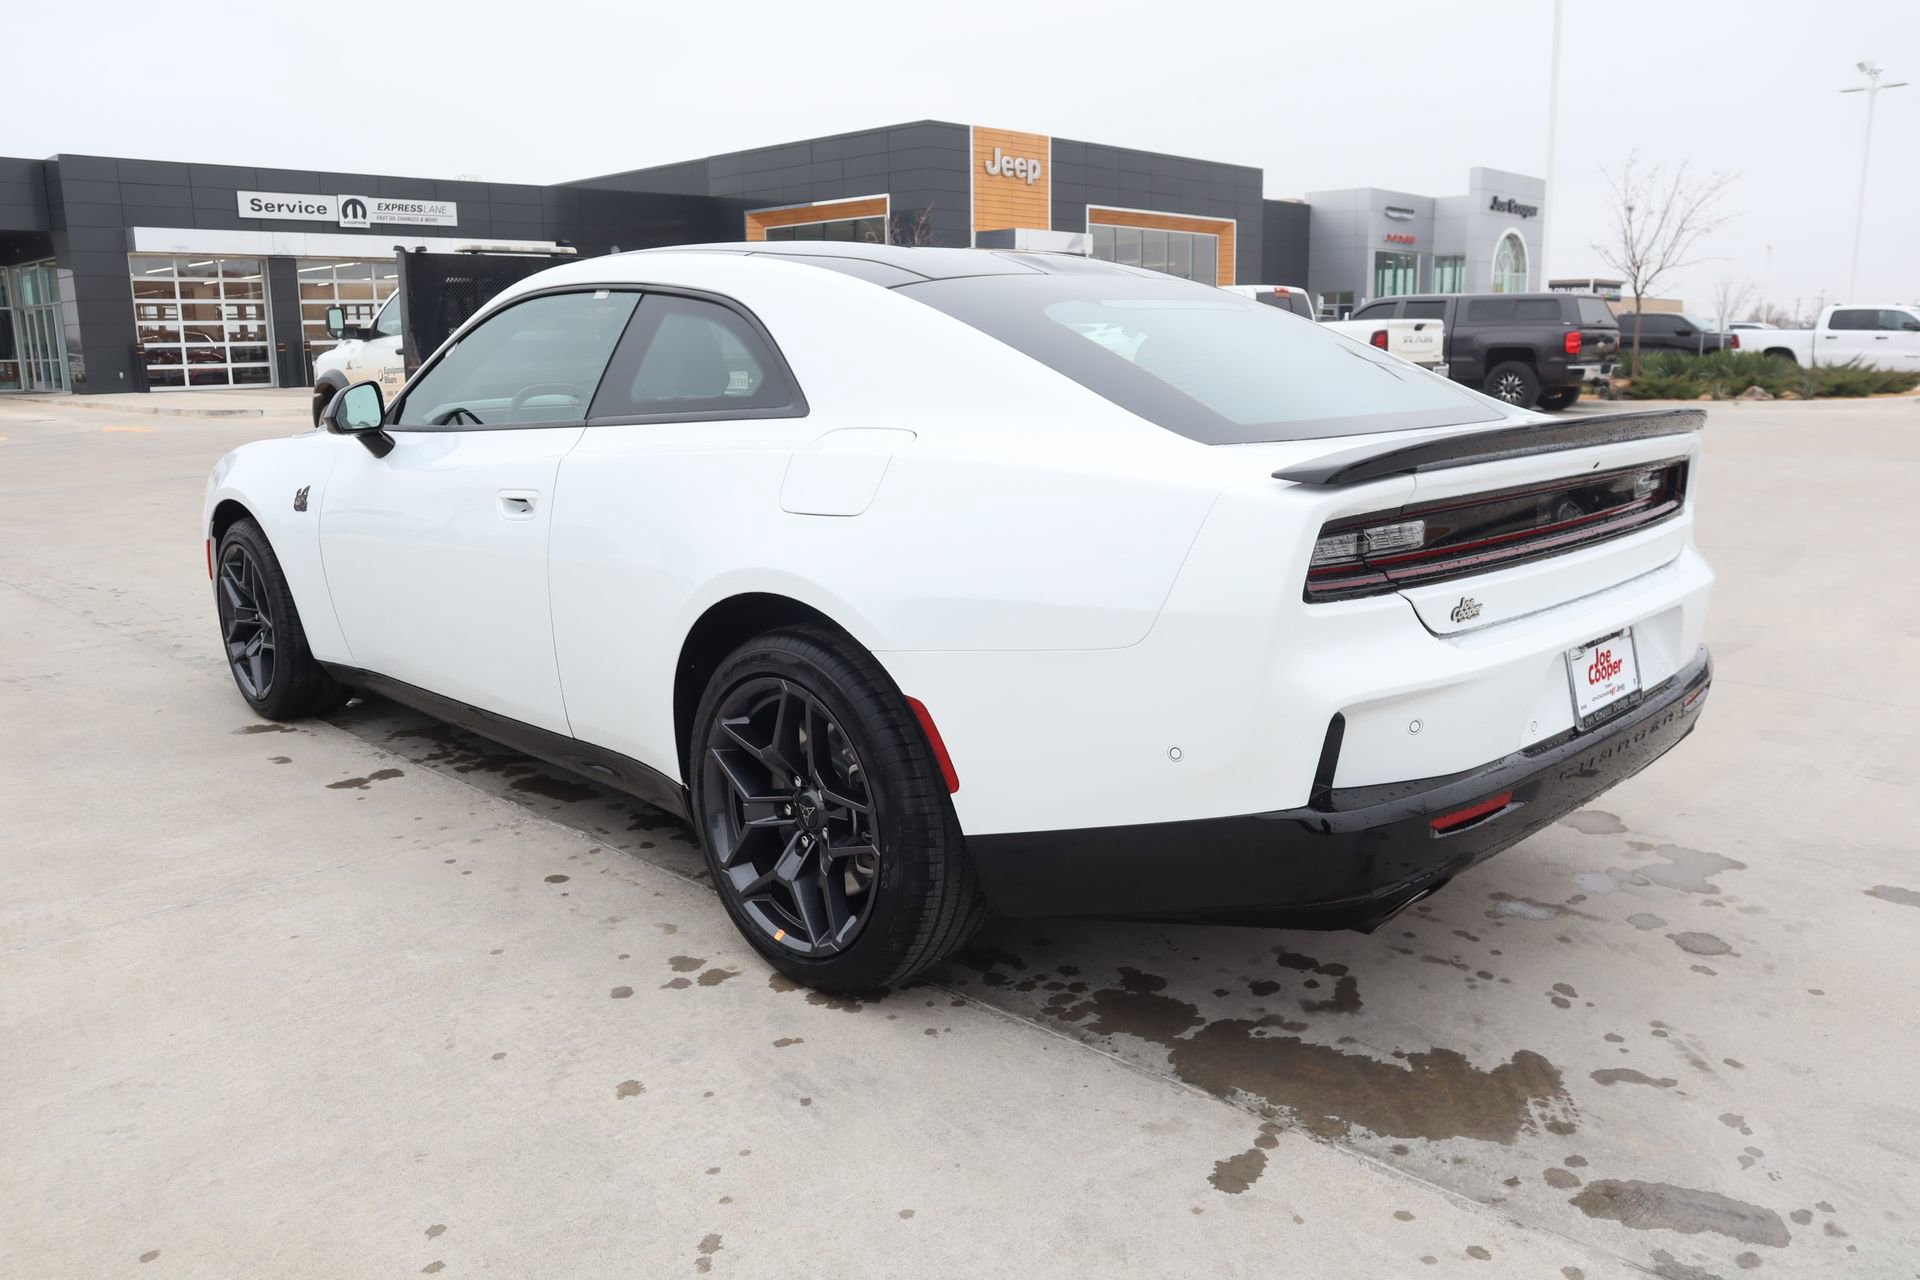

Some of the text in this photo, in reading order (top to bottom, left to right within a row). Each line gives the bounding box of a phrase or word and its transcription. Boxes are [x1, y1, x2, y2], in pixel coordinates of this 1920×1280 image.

[984, 147, 1041, 186] Jeep
[250, 198, 328, 215] Service
[1451, 603, 1483, 622] Cooper
[1460, 597, 1475, 610] Joe
[1594, 647, 1612, 669] Joe
[1588, 658, 1623, 685] Cooper
